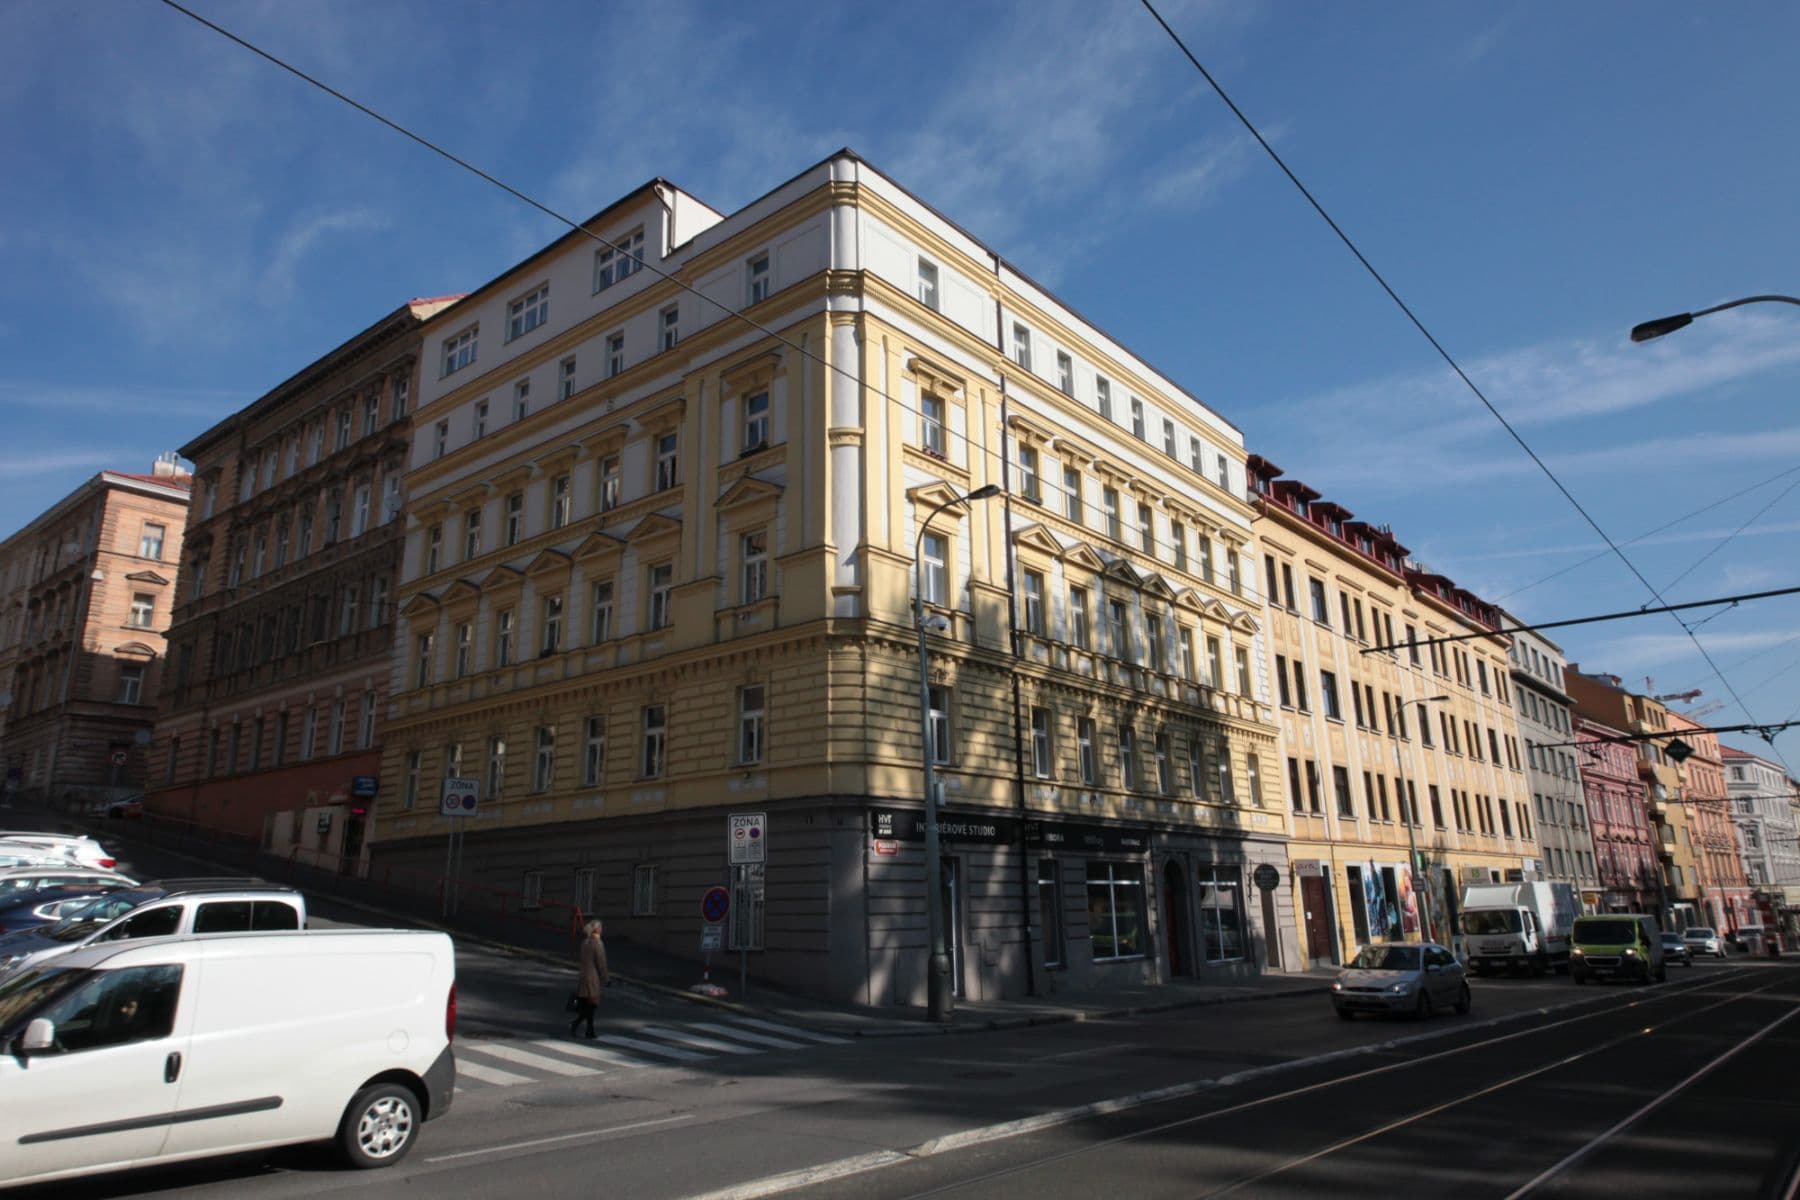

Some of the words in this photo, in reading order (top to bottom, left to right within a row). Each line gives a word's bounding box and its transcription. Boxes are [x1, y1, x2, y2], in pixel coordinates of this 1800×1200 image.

[448, 781, 474, 790] ZONA
[733, 817, 760, 827] ZONA
[968, 825, 996, 836] STUDIO
